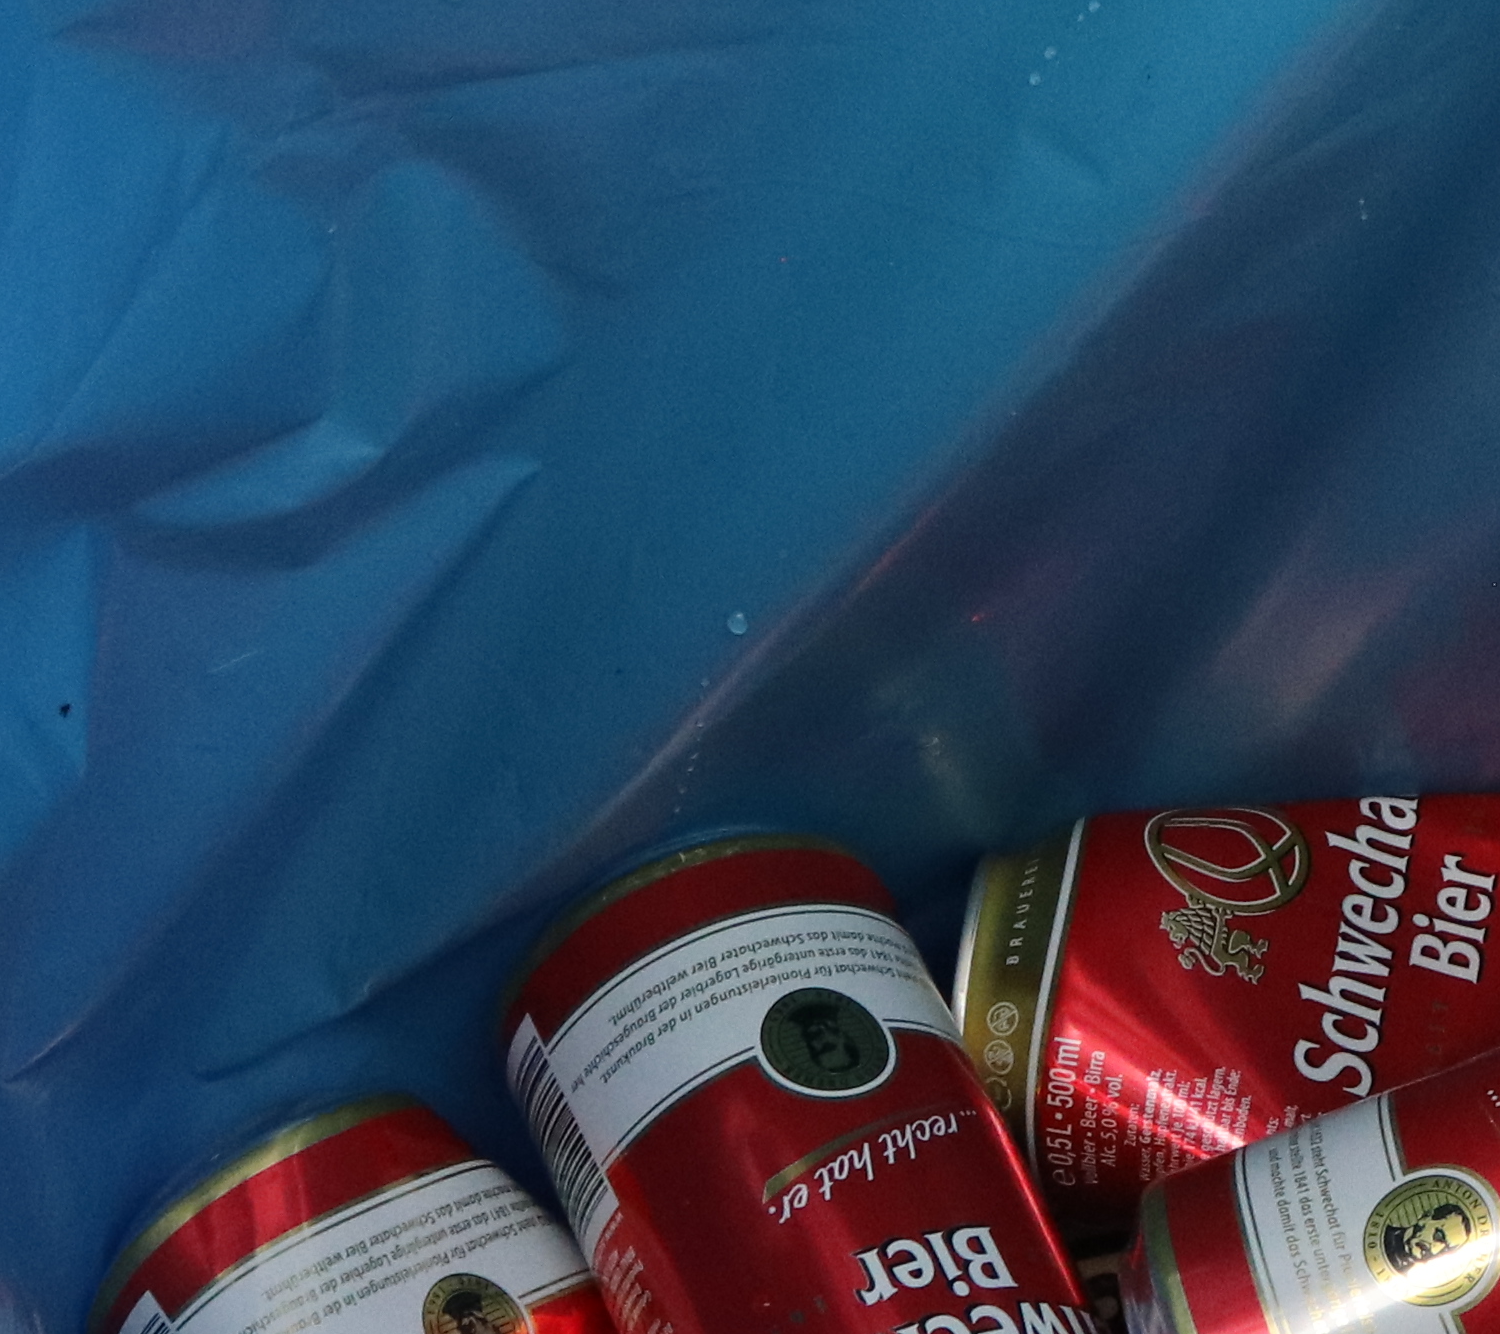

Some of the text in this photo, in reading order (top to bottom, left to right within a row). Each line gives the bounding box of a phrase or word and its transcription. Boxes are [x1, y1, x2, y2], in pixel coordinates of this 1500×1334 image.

[1410, 853, 1499, 984] Bier
[690, 956, 718, 975] Bier
[720, 933, 806, 964] Schwechater
[607, 970, 690, 1028] weltberühmt.
[694, 969, 812, 1015] Pionierleistungen
[583, 949, 817, 1079] untergärige Lagerbier der Braugeschichte
[657, 1018, 678, 1037] der
[1083, 1050, 1106, 1086] Birra
[1080, 1095, 1098, 1128] Beer
[813, 1148, 876, 1203] hat
[767, 1177, 810, 1226] er.
[1314, 1168, 1342, 1231] Schwechat
[338, 1253, 392, 1285] Lagerbier
[343, 1239, 370, 1260] Bier
[852, 1226, 1019, 1310] Bier
[322, 1299, 343, 1319] der
